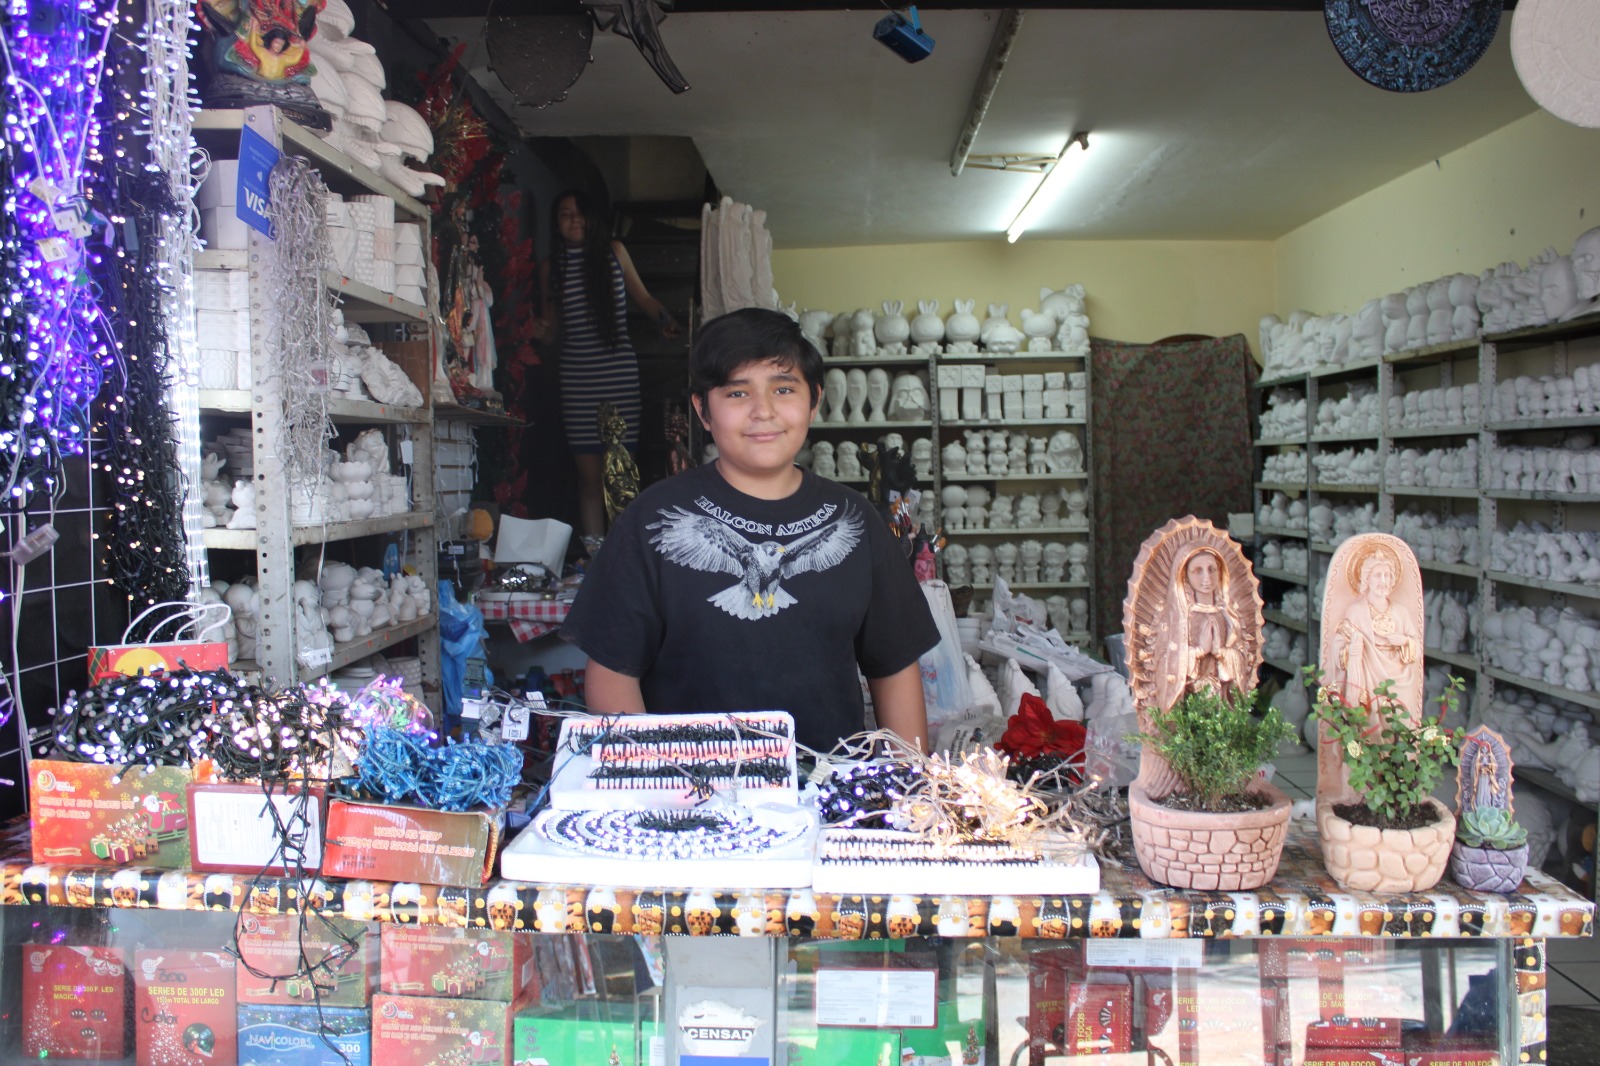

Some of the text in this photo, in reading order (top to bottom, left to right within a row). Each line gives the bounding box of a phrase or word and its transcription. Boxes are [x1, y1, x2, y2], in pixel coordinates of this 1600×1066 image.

[775, 503, 837, 536] AZTECA
[54, 984, 71, 992] SERIE
[148, 986, 225, 997] SERIES DE 300F LED
[1077, 1012, 1085, 1037] FOCOS
[339, 1043, 361, 1053] 300
[1085, 1025, 1093, 1054] MGICA
